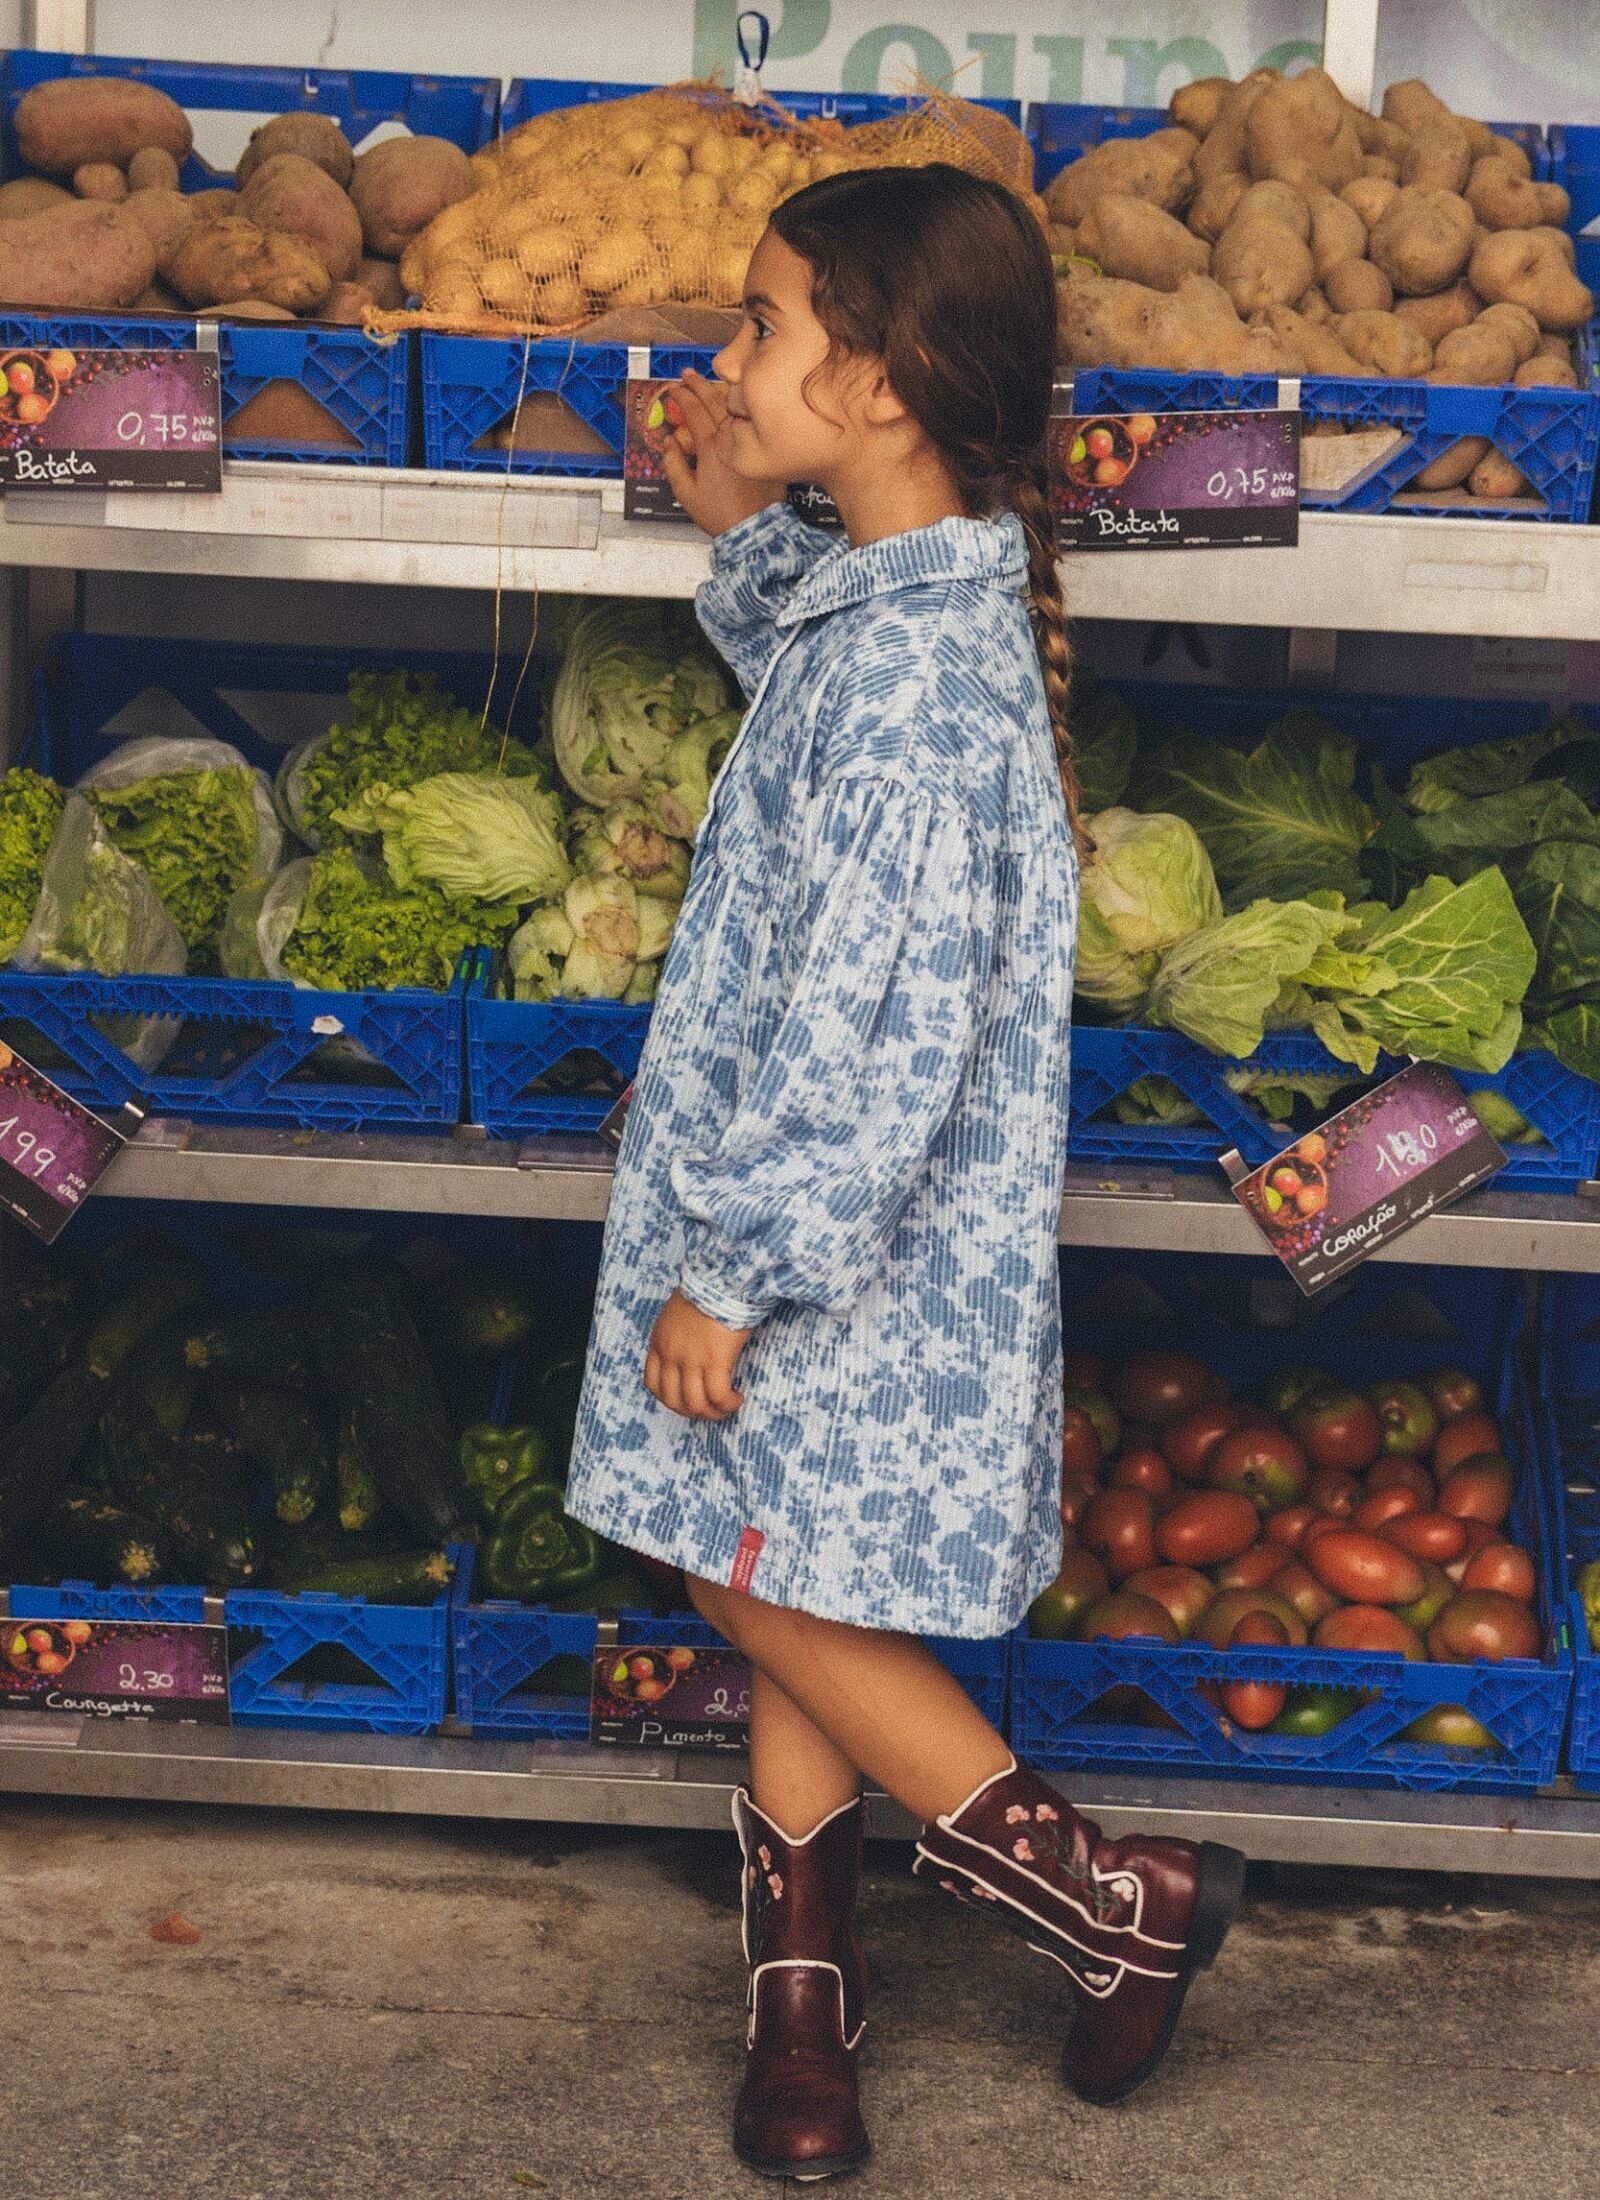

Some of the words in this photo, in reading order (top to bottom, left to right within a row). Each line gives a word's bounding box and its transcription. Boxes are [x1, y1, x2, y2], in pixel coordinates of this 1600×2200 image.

[117, 411, 188, 446] 0,75
[15, 449, 97, 480] Batata
[1206, 467, 1269, 500] 0,75
[1089, 508, 1180, 536] Batata
